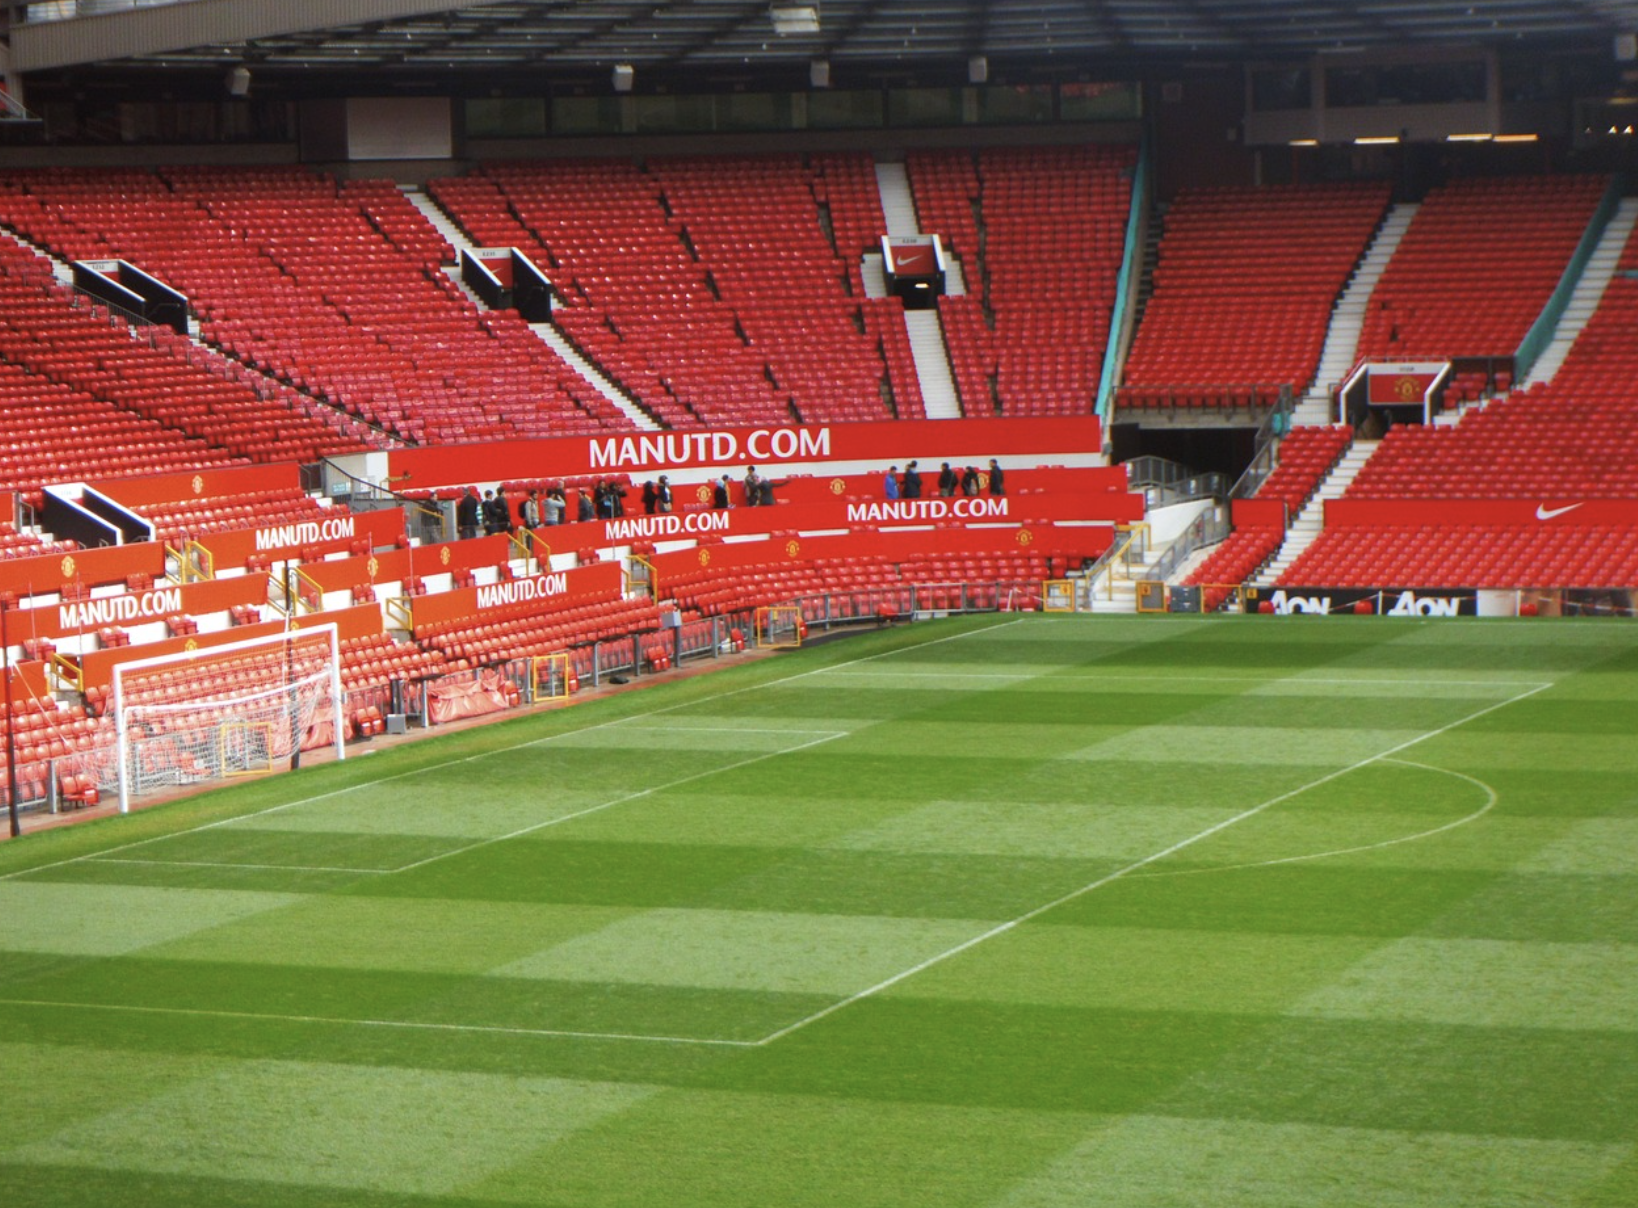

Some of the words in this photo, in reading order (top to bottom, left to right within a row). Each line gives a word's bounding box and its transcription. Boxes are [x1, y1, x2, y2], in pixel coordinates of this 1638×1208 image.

[590, 428, 830, 467] MANUTD.COM
[605, 512, 729, 540] MANUTD.COM
[847, 498, 1008, 522] MANUTD.COM
[256, 518, 355, 550] MANUTD.COM
[476, 573, 567, 608] MANUTD.COM
[59, 590, 181, 629] MANUTD.COM
